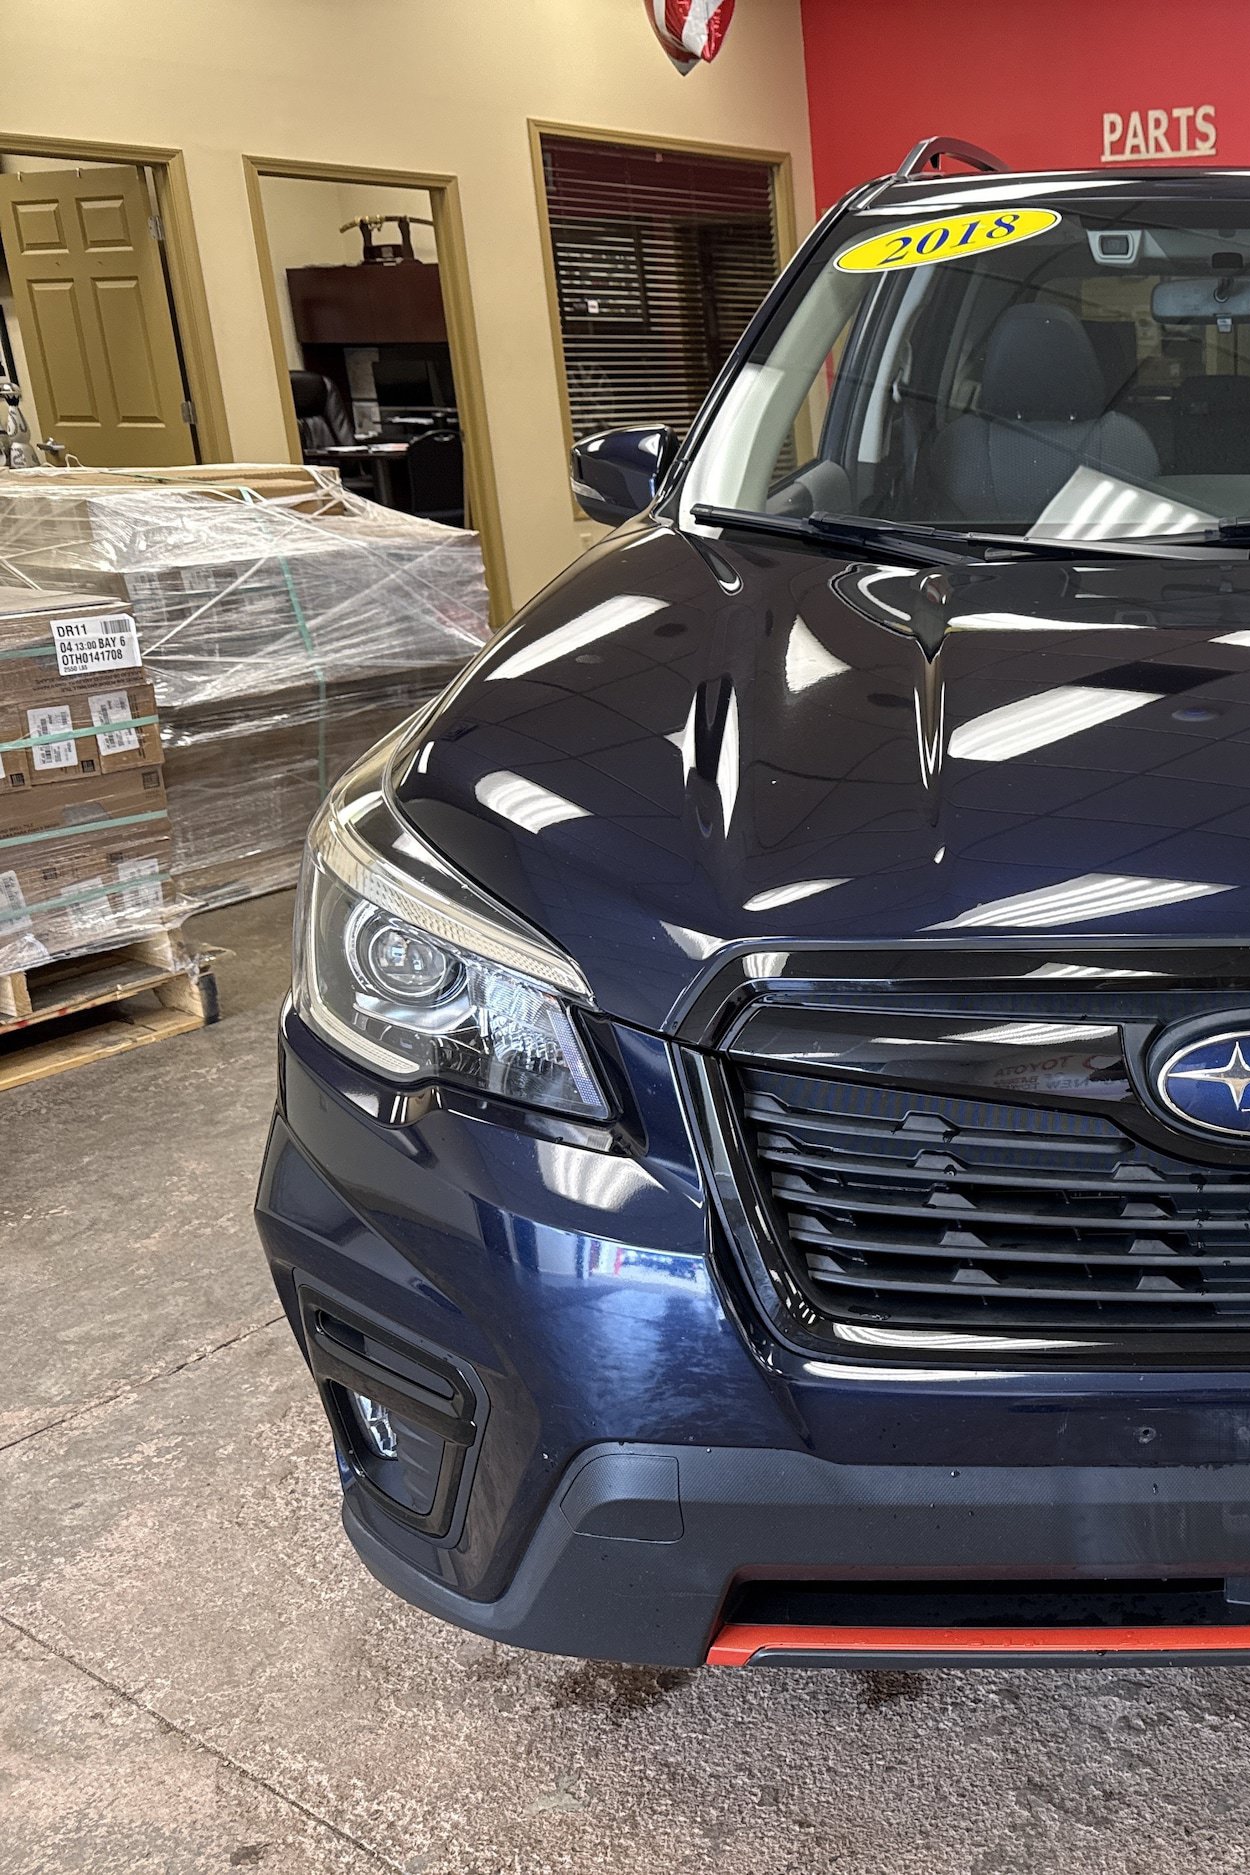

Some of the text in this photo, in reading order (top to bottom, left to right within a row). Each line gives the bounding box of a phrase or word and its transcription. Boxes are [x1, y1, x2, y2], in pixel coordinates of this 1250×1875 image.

[1102, 105, 1217, 157] PARTS
[876, 213, 1020, 266] 2018
[56, 624, 87, 638] DR11
[60, 635, 126, 653] 04 13:00 BAY 6
